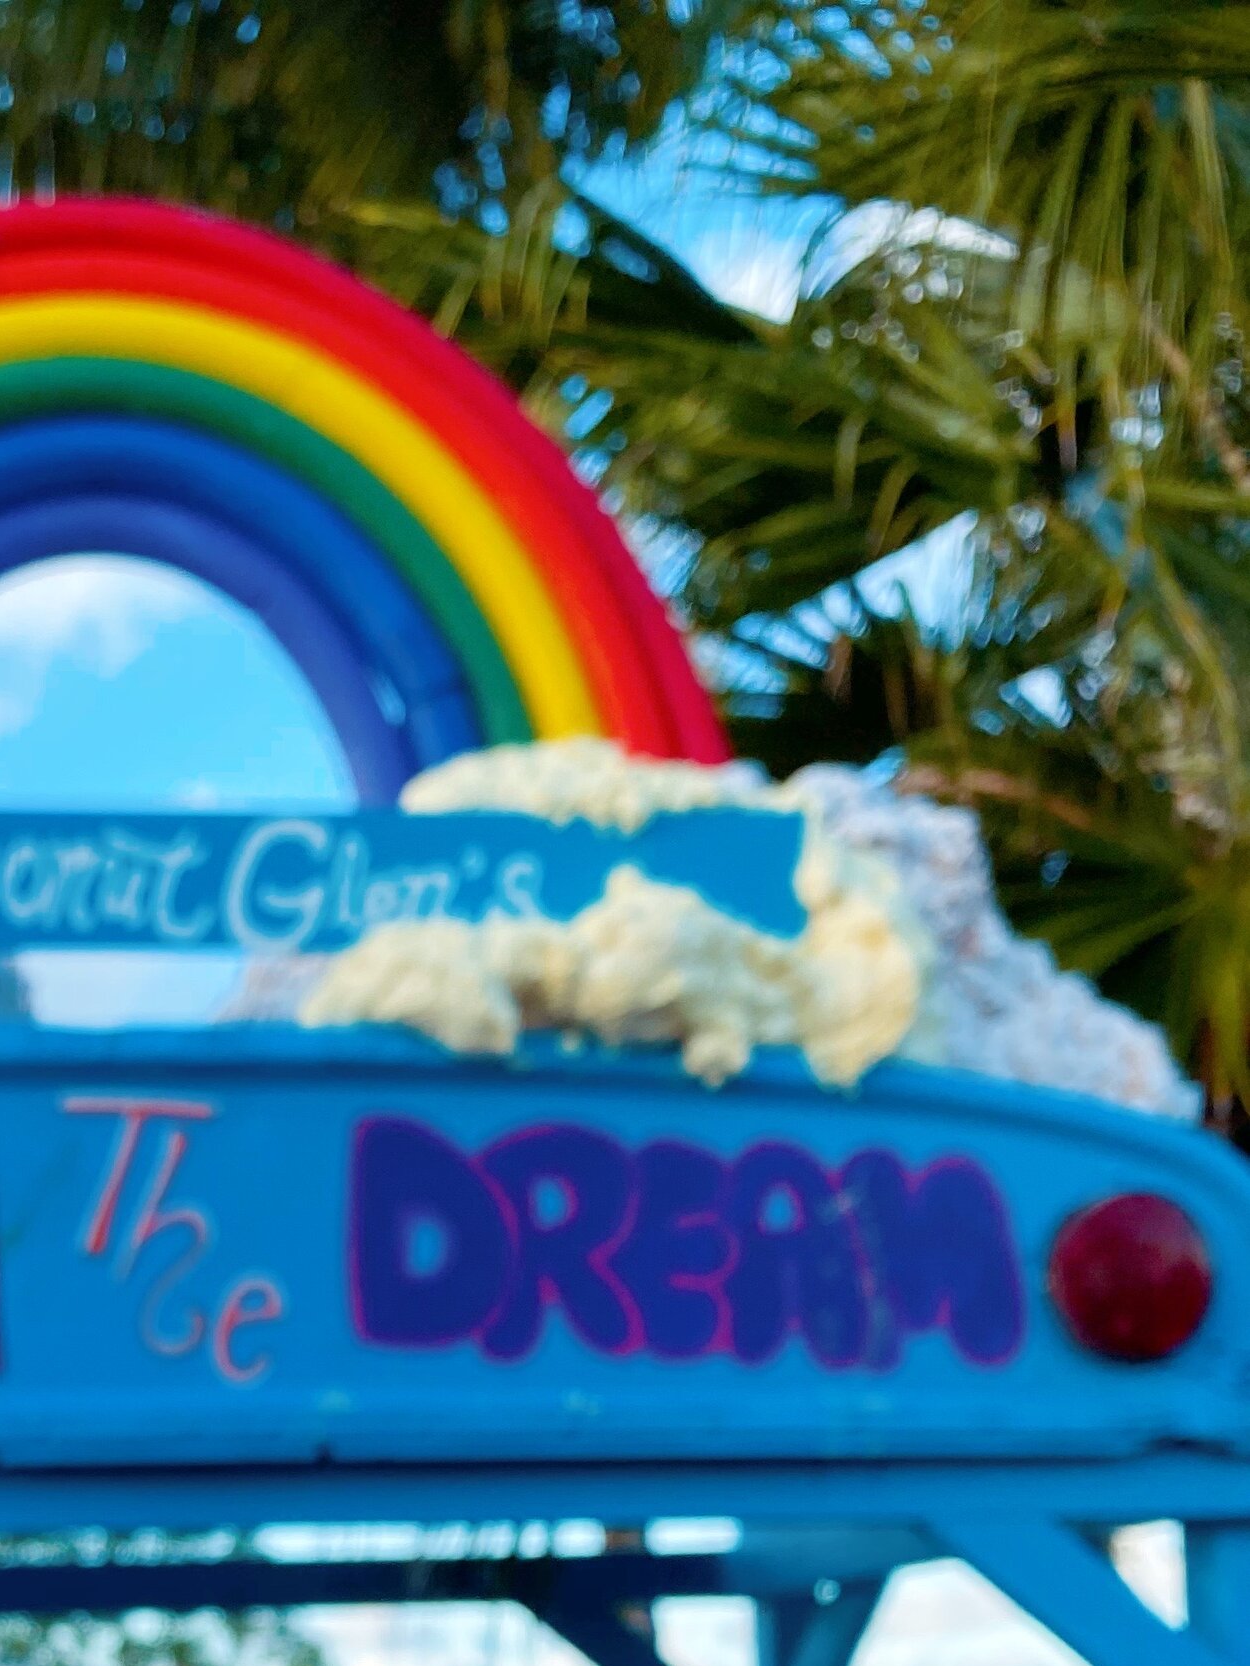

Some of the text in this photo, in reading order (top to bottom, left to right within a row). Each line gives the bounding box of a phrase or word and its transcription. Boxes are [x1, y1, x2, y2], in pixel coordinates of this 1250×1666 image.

[224, 817, 546, 949] Glen's
[59, 1096, 283, 1383] The
[348, 1112, 1026, 1372] DREAM
